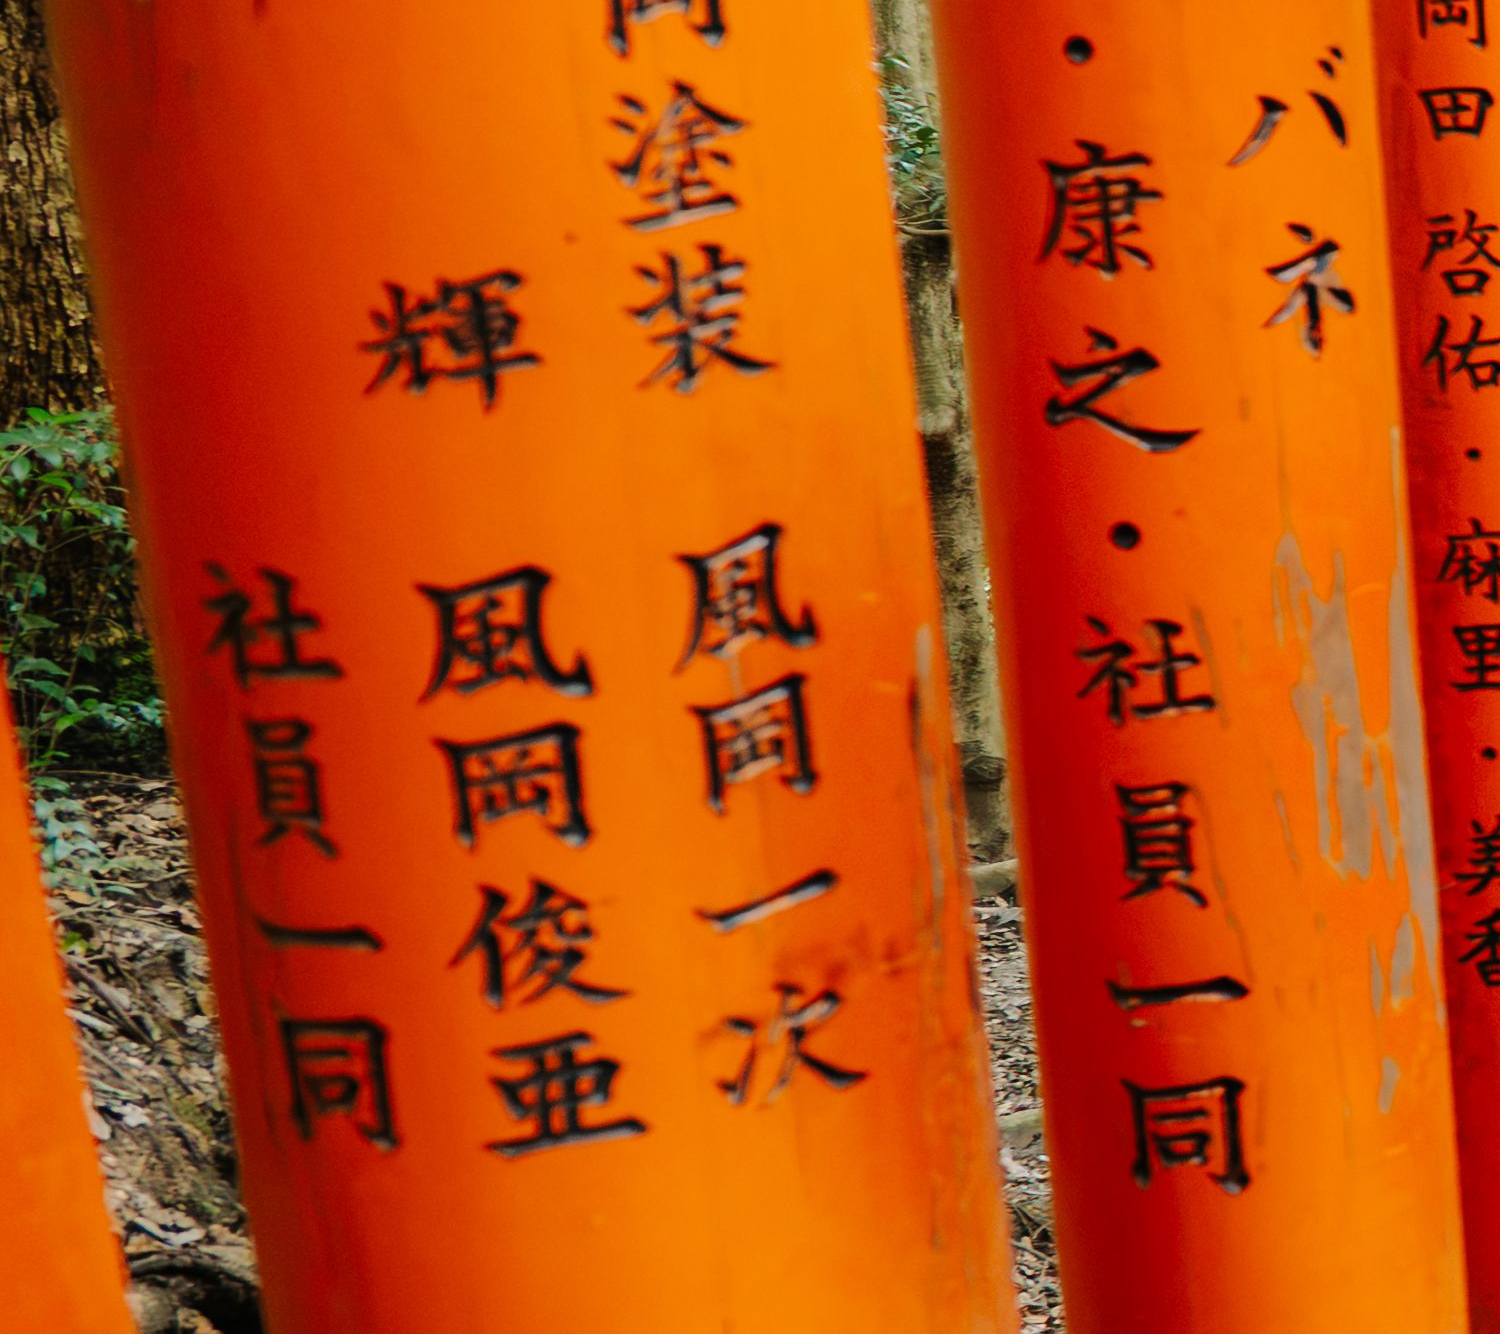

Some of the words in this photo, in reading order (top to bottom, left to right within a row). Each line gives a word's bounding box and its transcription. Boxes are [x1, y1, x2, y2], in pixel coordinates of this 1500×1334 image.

[363, 270, 540, 407] 輝
[202, 560, 400, 1153] 社員一同
[417, 565, 648, 1159] 風岡俊亜
[678, 522, 867, 1103] 風岡一次
